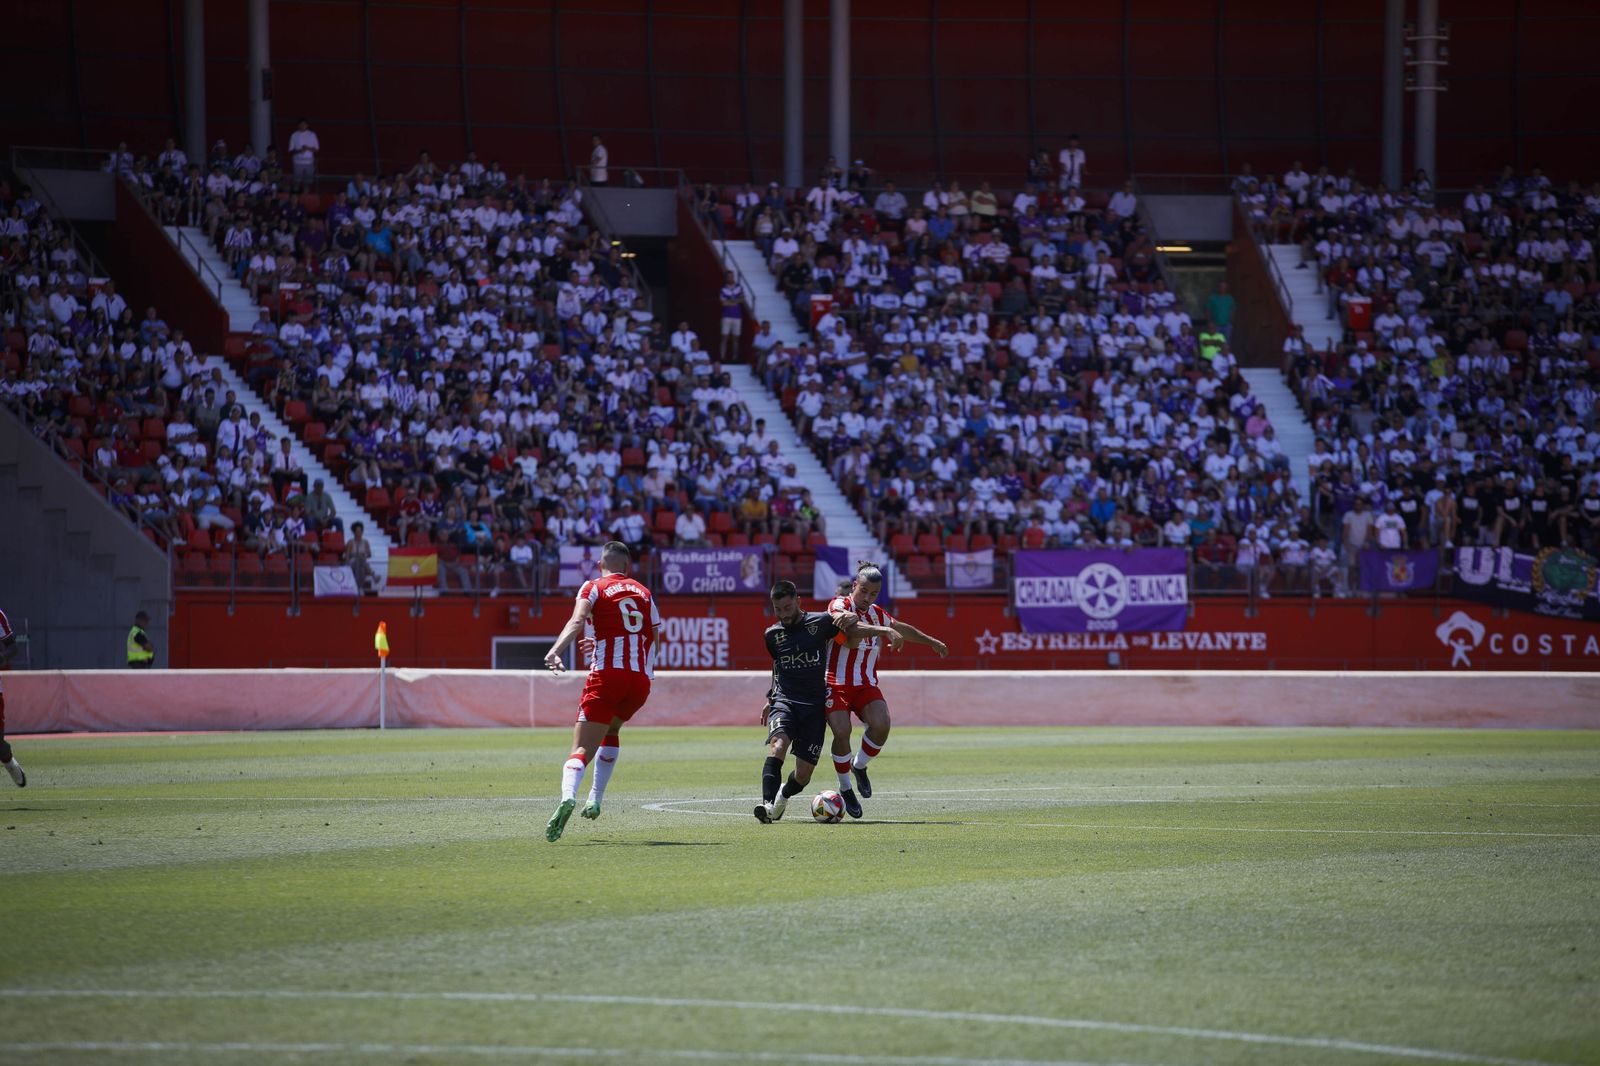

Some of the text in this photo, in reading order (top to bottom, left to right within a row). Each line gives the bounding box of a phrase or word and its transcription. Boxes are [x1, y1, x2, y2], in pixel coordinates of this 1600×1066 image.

[705, 563, 721, 577] EL
[691, 576, 736, 592] CHATO
[1017, 577, 1183, 604] CRUZADA BLANCA
[619, 597, 644, 633] 6
[1001, 631, 1128, 651] ESTRELLA
[1151, 632, 1267, 651] LEVANTE
[1489, 633, 1600, 656] COSTA
